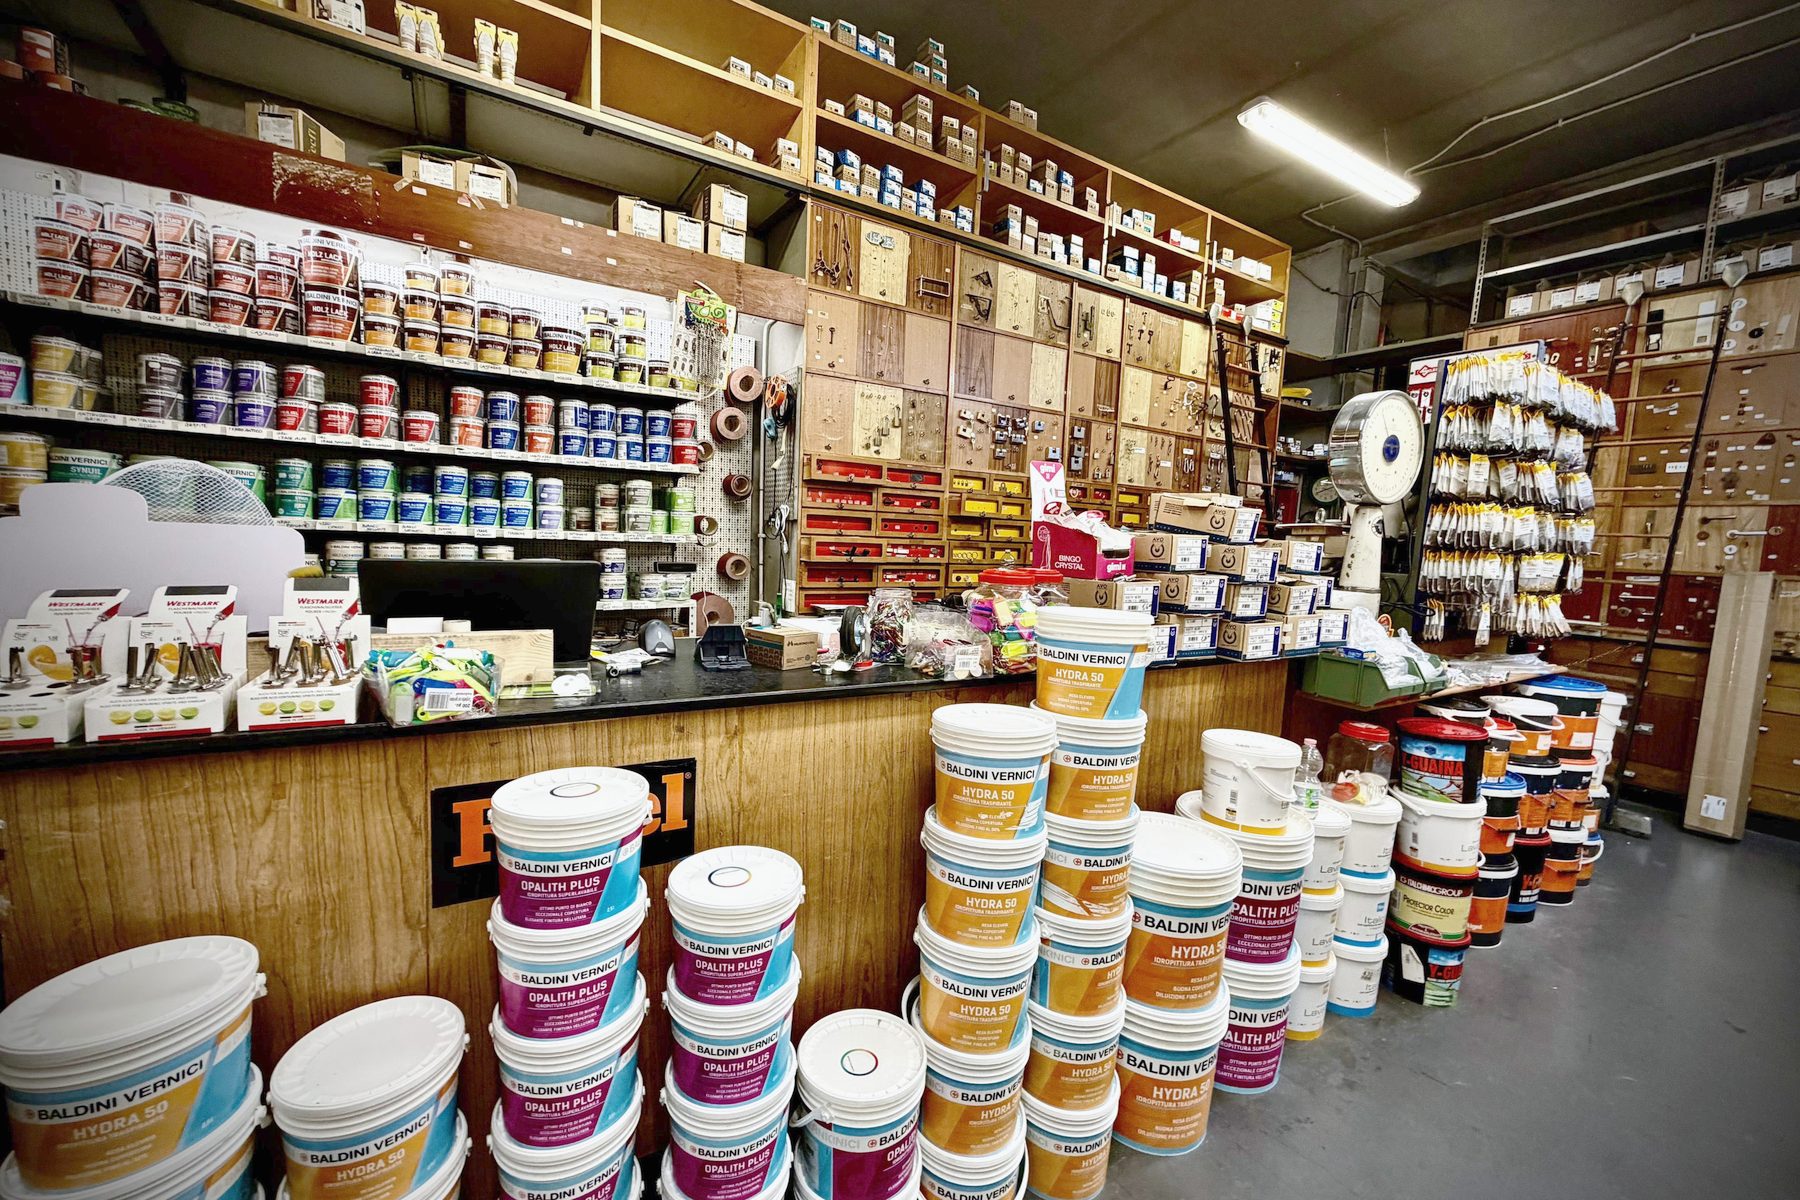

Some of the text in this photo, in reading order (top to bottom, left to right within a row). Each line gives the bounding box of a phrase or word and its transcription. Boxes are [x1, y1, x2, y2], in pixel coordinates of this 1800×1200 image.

[70, 456, 109, 467] VERNICI
[1054, 562, 1086, 572] CRYSTAL
[297, 597, 345, 605] WESTMARK
[1043, 648, 1126, 665] BALDINI VERNICI
[1055, 668, 1104, 682] HYDRA 50
[1073, 755, 1118, 767] BALDINI
[946, 762, 1036, 781] BALDINI VERNICI
[1093, 774, 1125, 785] HYDRA
[962, 786, 1015, 801] HYDRA 50
[514, 855, 612, 874] BALDINI VERNICI
[1083, 857, 1123, 868] BALDINI
[521, 876, 601, 893] OPALITH PLUS
[947, 872, 1035, 890] BALDINI VERNICI
[1242, 882, 1273, 896] DINI
[966, 896, 1018, 909] HYDRA 50
[1233, 902, 1300, 919] PALITH PLUS
[1434, 904, 1455, 915] COLOR
[1144, 915, 1208, 935] BALDINI
[689, 938, 773, 956] BALDINI VERNICI
[1171, 943, 1215, 959] HYDRA
[695, 957, 763, 972] OPALITH PLUS
[1153, 956, 1195, 968] IDROPITTURA
[521, 957, 618, 985] BALDINI VERNICI
[528, 979, 608, 1003] OPALITH PLUS
[941, 979, 988, 998] BALDINI
[960, 1004, 1011, 1017] HYDRA 50
[1229, 1009, 1258, 1024] DINI
[697, 1030, 779, 1057] BALDINI VERNICI
[1224, 1030, 1262, 1046] ALITH
[703, 1052, 771, 1073] OPALITH PLUS
[1053, 1050, 1097, 1062] BALDINI
[1072, 1067, 1103, 1079] HYDRA
[1126, 1053, 1191, 1077] BALDINI
[517, 1066, 613, 1096] BALDINI VERNICI
[37, 1059, 204, 1121] BALDINI VERNICI
[960, 1090, 1006, 1103] BALDINI
[1152, 1086, 1199, 1100] HYDRA
[524, 1088, 603, 1113] OPALITH PLUS
[73, 1114, 141, 1141] HYDRA
[143, 1099, 170, 1119] 50
[980, 1104, 1012, 1120] HYDRA
[310, 1113, 431, 1165] BALDINI VERNICI
[697, 1128, 779, 1159] BALDINI VERNICI
[1063, 1140, 1103, 1154] BALDINI
[336, 1160, 386, 1181] HYDRA
[388, 1148, 406, 1164] 50
[704, 1149, 771, 1174] OPALITH PLUS
[577, 1160, 620, 1194] VERNICI
